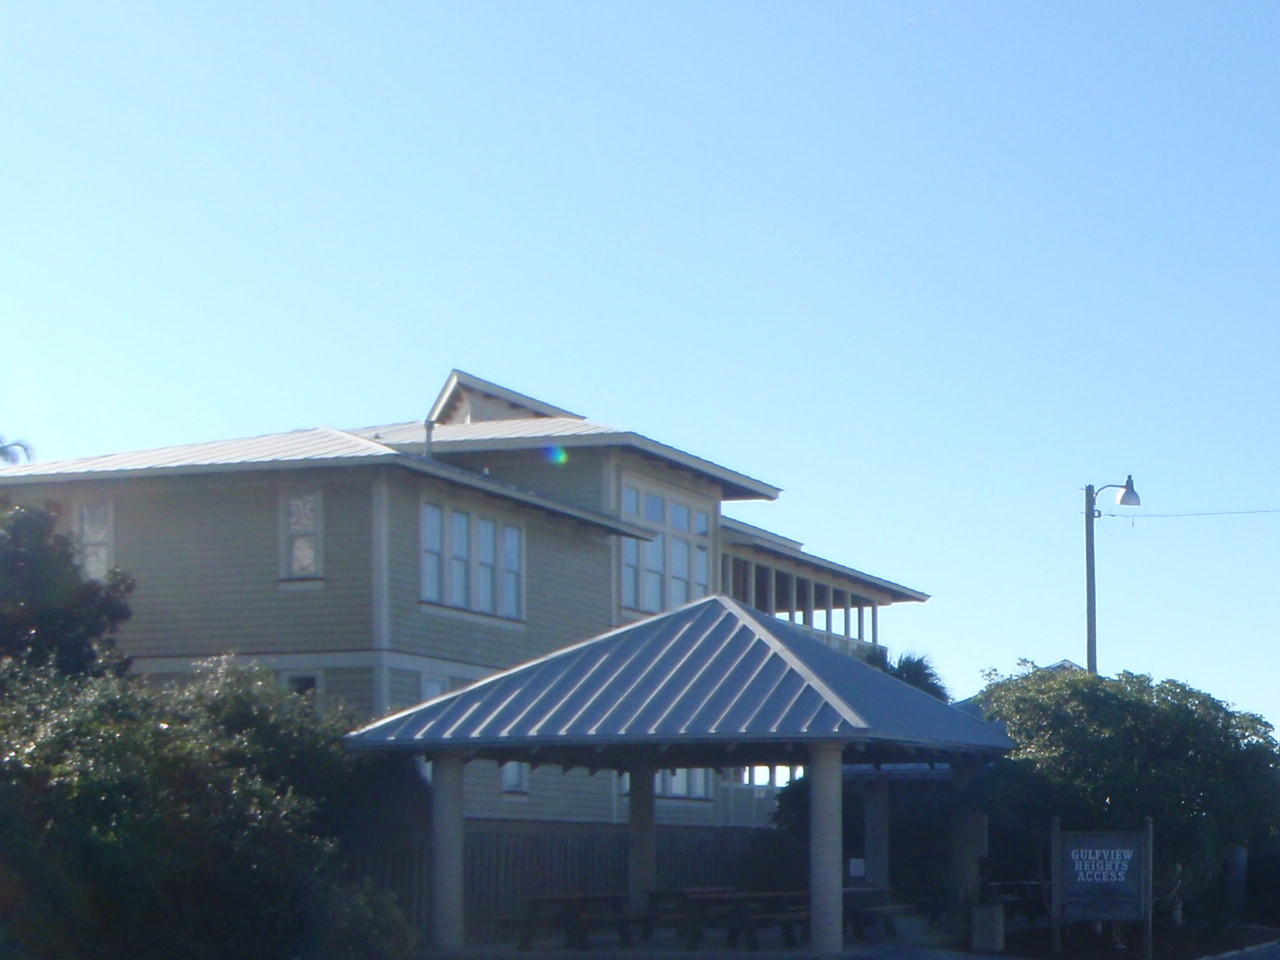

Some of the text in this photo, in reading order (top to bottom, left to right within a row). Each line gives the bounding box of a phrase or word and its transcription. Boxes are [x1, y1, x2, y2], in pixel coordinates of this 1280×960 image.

[1071, 849, 1133, 860] GULFVIEW
[1074, 860, 1128, 871] HEIGHTS
[1077, 871, 1125, 882] ACCESS
